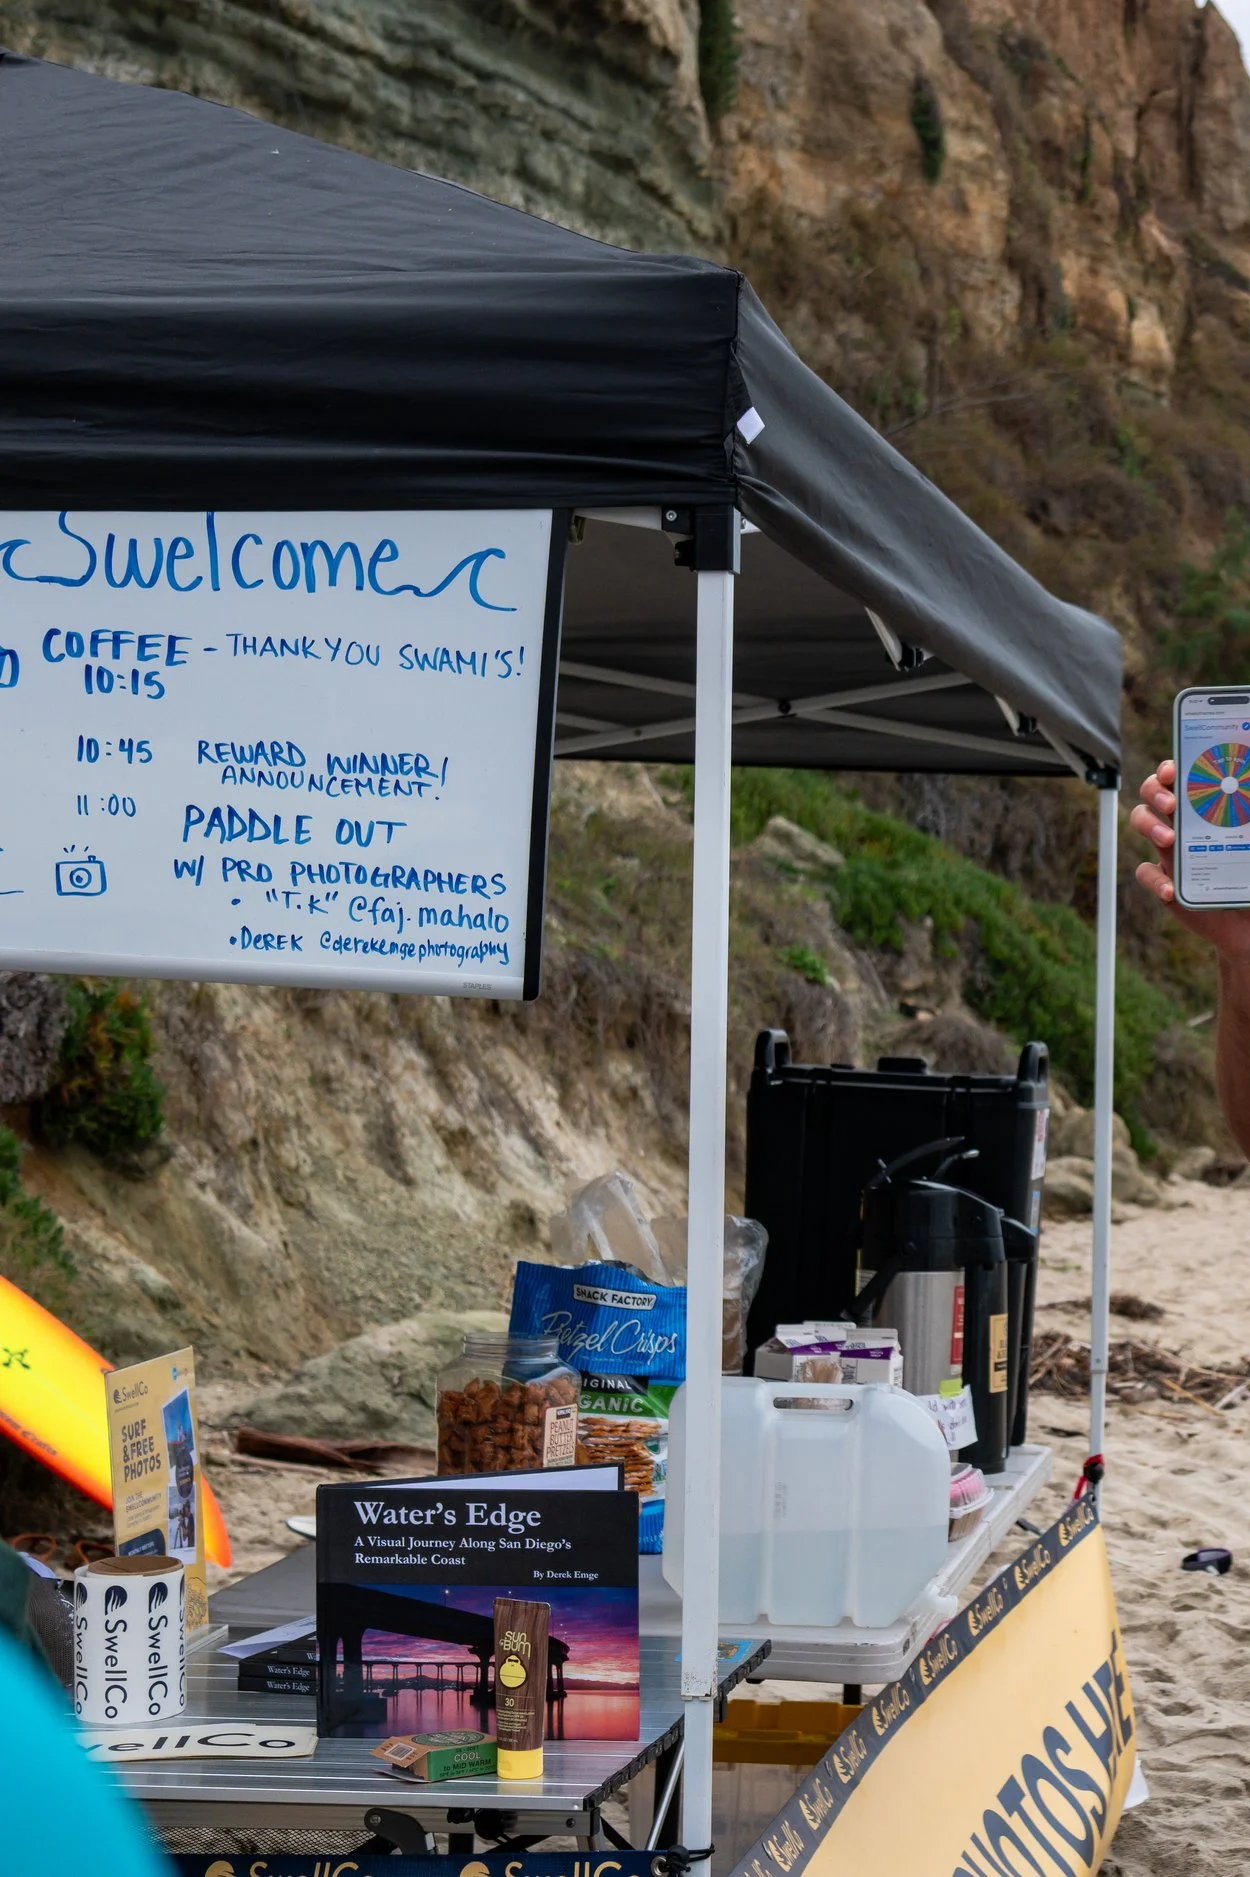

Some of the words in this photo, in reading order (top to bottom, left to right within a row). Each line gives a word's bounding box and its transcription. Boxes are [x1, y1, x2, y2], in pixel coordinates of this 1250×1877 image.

[36, 511, 399, 596] Swelcome
[42, 627, 193, 667] COFFEE
[398, 643, 525, 679] SWAMI'S!
[84, 663, 166, 701] 10:15
[76, 734, 154, 765] 10:45
[197, 739, 307, 768] REWARD
[76, 793, 137, 818] 11:00
[182, 803, 313, 845] PADDLE
[335, 817, 408, 848] OUT
[221, 856, 273, 883] PRO
[290, 861, 508, 900] PHOTOGRAPHERS
[575, 1287, 608, 1303] SNACK
[611, 1293, 654, 1308] FACTORY
[541, 1310, 619, 1362] Pretzel
[611, 1318, 679, 1366] Crisps
[121, 1380, 149, 1403] SwellCo
[582, 1377, 632, 1390] IGINAL
[578, 1393, 644, 1413] GANIC
[121, 1418, 147, 1443] SURF
[550, 1418, 574, 1435] PEANUT
[549, 1431, 575, 1446] BUTTER
[546, 1442, 575, 1459] PRETZELS
[124, 1452, 162, 1483] PHOTOS
[353, 1500, 457, 1527] Water's
[465, 1502, 542, 1535] Edge
[353, 1535, 365, 1548] A
[367, 1535, 406, 1549] Visual
[408, 1536, 457, 1551] Journey
[458, 1537, 496, 1552] Along
[499, 1538, 522, 1550] San
[524, 1538, 572, 1554] Diego's
[354, 1553, 428, 1566] Remarkable
[430, 1554, 466, 1566] Coast
[532, 1569, 545, 1580] By
[546, 1569, 573, 1579] Derek
[574, 1570, 599, 1582] Emge
[75, 1615, 88, 1716] SwellCo
[104, 1619, 128, 1719] SwellCo
[148, 1614, 169, 1716] SwellCo
[266, 1664, 291, 1676] Water's
[292, 1666, 310, 1678] Edge
[266, 1681, 291, 1692] Water's
[292, 1682, 310, 1694] Edge
[504, 1697, 515, 1708] 30
[86, 1732, 296, 1752] ellCo
[452, 1761, 467, 1771] MID
[468, 1758, 492, 1769] WARM
[454, 1751, 482, 1763] COOL
[953, 1726, 1108, 1877] OTOS
